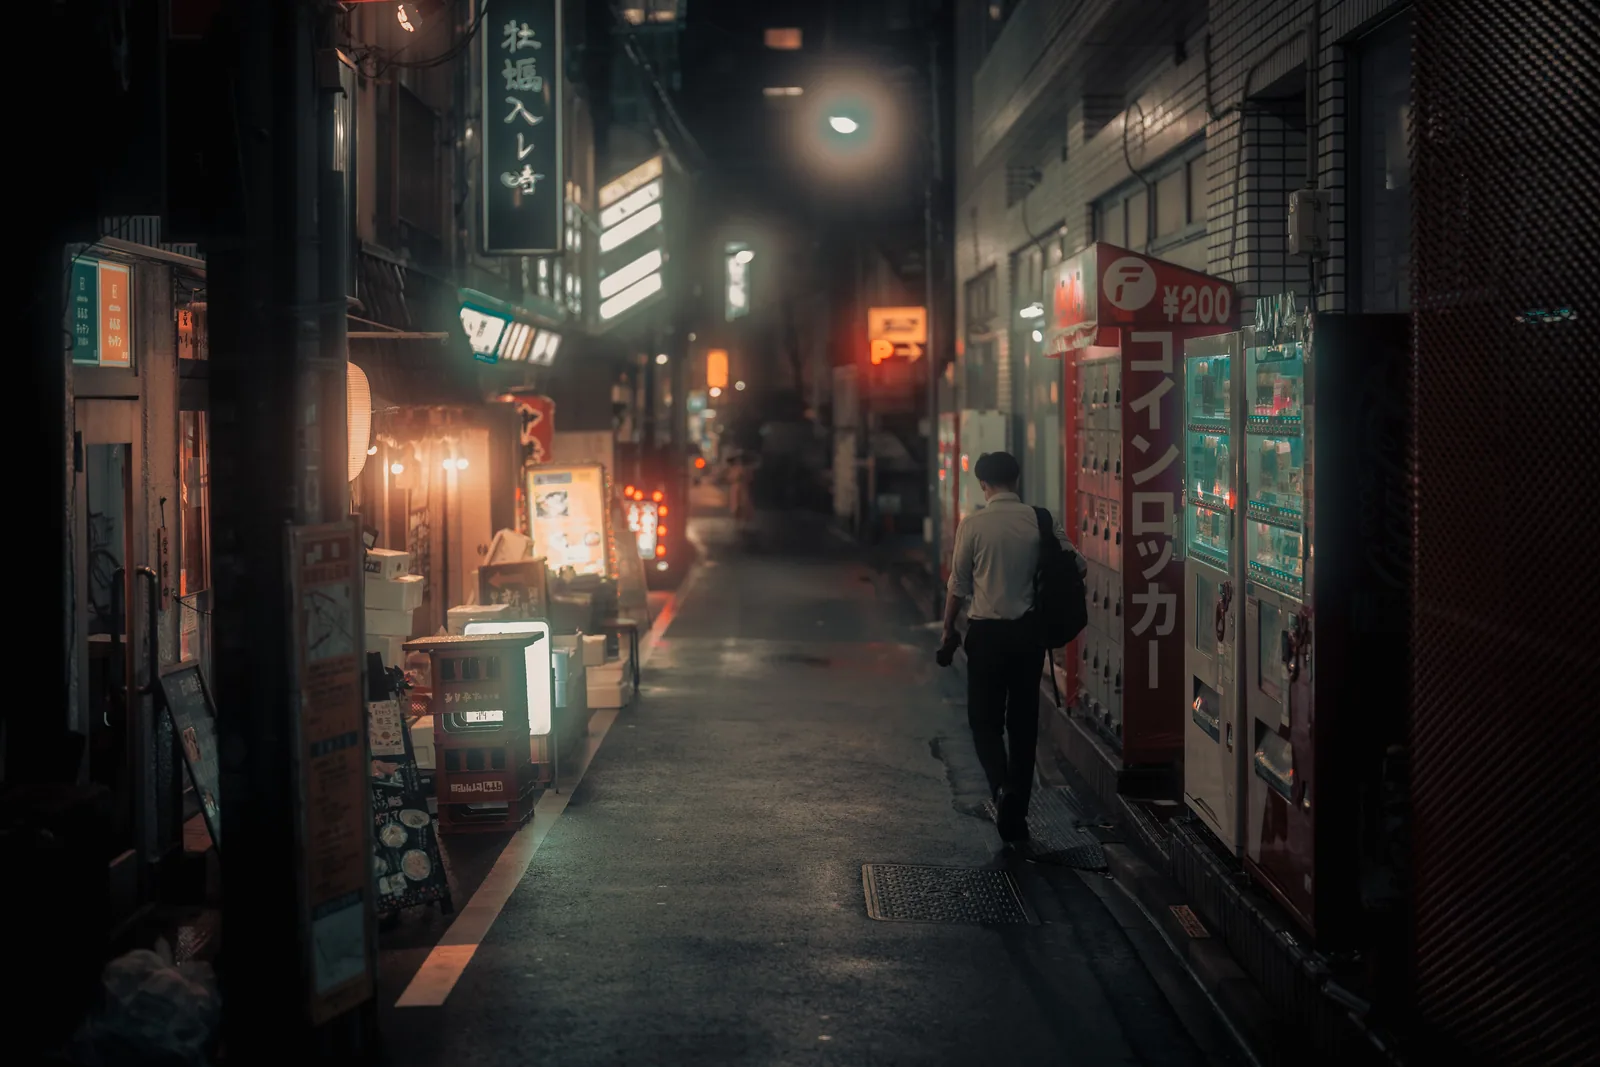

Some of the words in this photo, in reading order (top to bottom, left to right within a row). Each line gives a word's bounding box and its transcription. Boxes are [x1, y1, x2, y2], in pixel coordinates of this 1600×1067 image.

[1163, 285, 1231, 324] ¥200
[870, 339, 895, 365] P
[1129, 331, 1180, 690] コインロッカー
